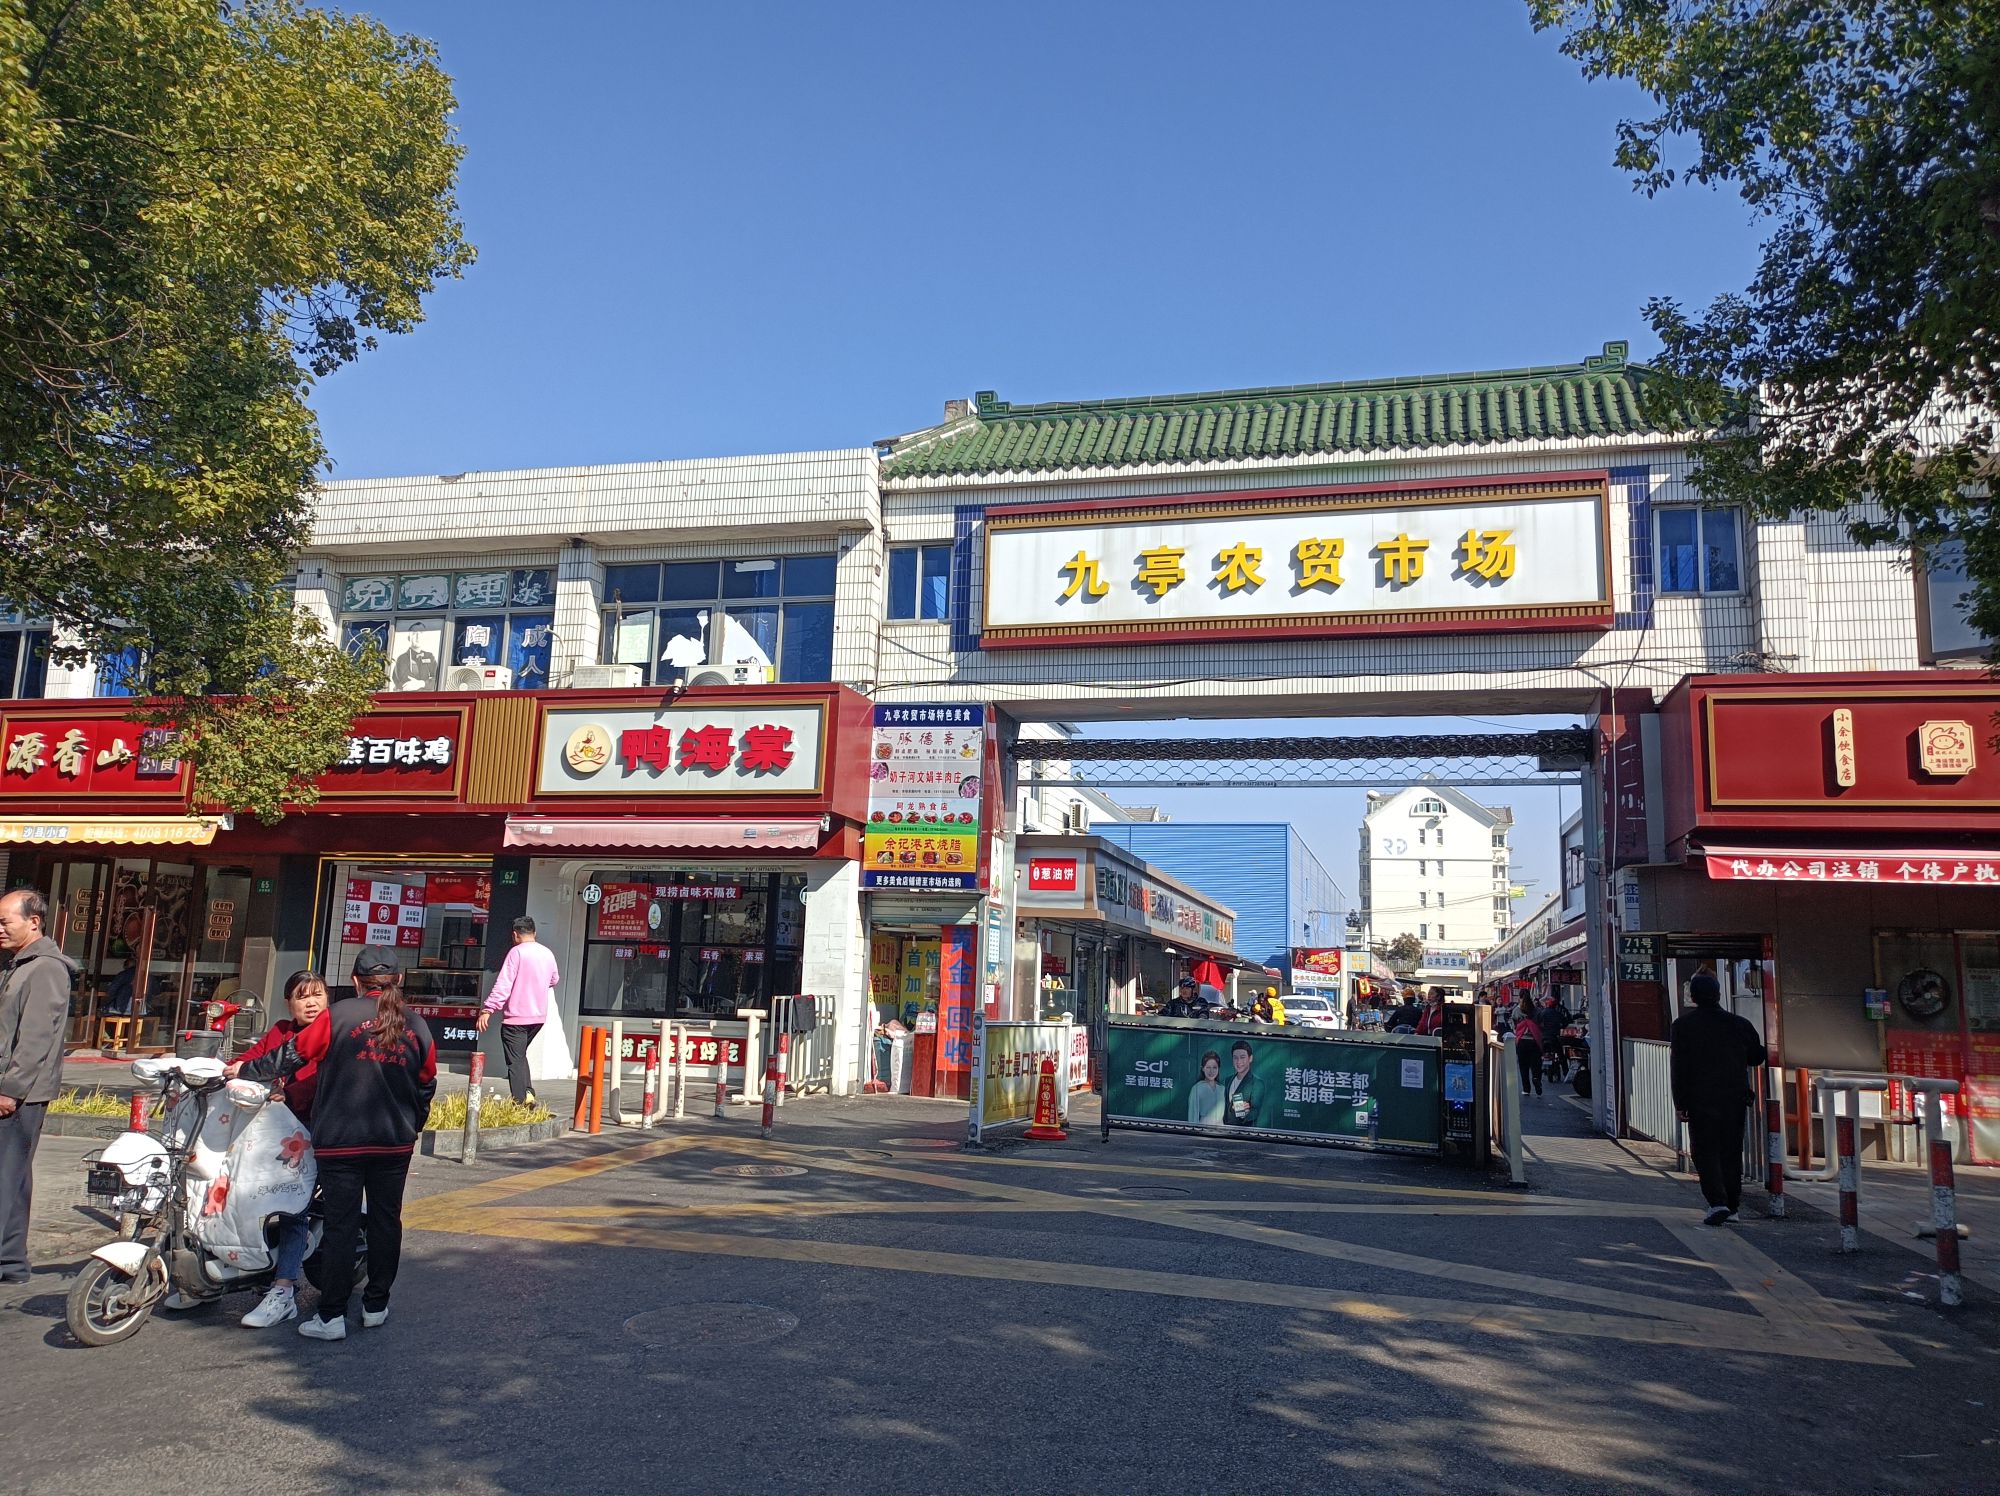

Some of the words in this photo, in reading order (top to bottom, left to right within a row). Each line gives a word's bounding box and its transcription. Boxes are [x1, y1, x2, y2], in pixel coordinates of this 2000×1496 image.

[1064, 528, 1516, 598] 九亭农贸市场
[884, 709, 971, 721] 九亭农贸市场特色美食
[6, 728, 135, 776] 源香山
[621, 724, 795, 770] 鸭海棠
[890, 771, 962, 784] 奶子河文娟羊肉庄
[896, 802, 948, 811] 阿龙熟食店
[1041, 867, 1074, 880] 葱油饼
[1731, 860, 1879, 880] 代办公司注销
[1896, 862, 1999, 881] 个体户执
[876, 876, 962, 887] 更多美食店铺请至市场内选购
[655, 886, 737, 899] 现捞卤味不隔夜
[602, 891, 637, 914] 招聘
[1624, 938, 1653, 949] 71号
[615, 948, 633, 958] 甜辣
[657, 949, 670, 959] 麻
[702, 949, 720, 959] 五香
[744, 951, 764, 961] 素菜
[907, 949, 939, 968] 首饰
[1426, 957, 1466, 967] 公共卫生间
[1625, 963, 1654, 974] 75弄
[943, 928, 974, 1064] 黄金回收
[443, 1027, 479, 1040] 34年专
[1125, 1074, 1174, 1089] 圣都整装
[1284, 1067, 1369, 1090] 装修选圣都
[1284, 1085, 1370, 1107] 透明每一步
